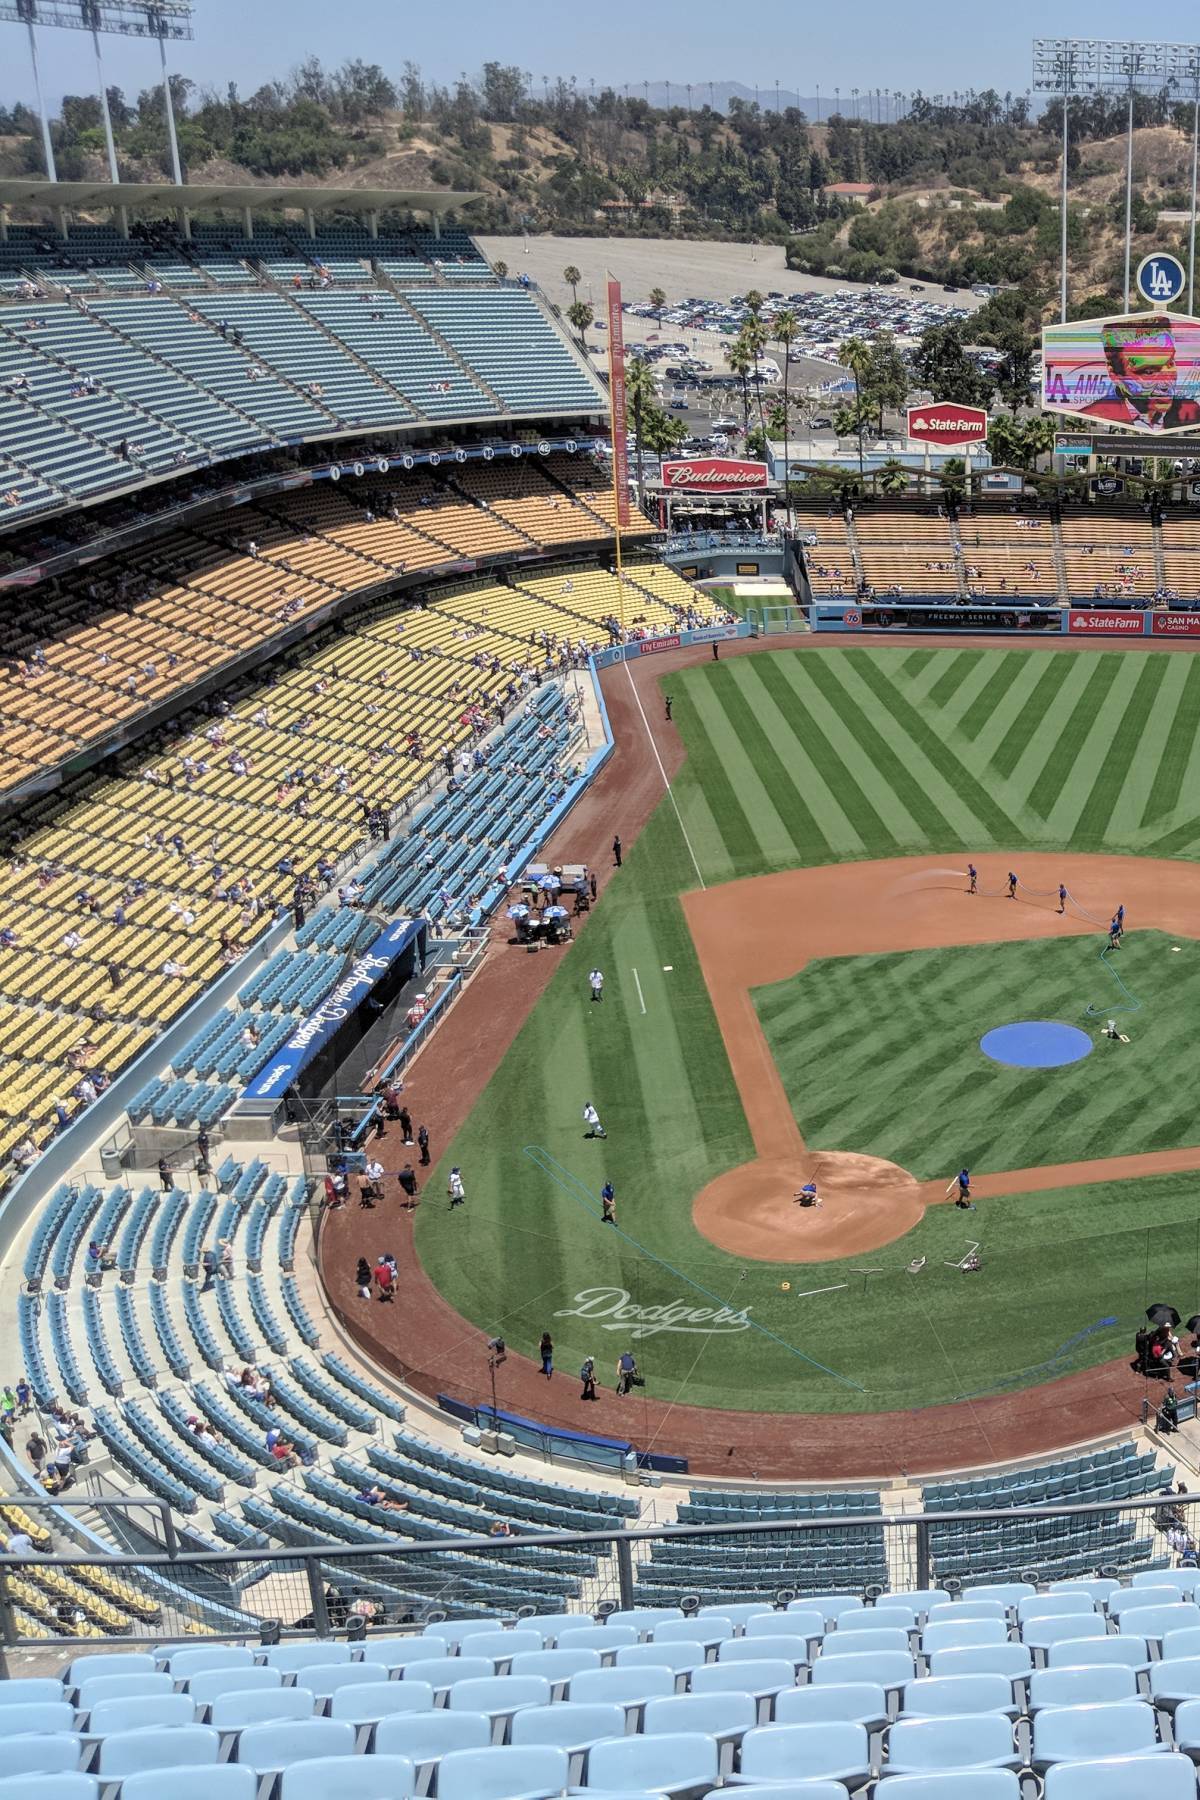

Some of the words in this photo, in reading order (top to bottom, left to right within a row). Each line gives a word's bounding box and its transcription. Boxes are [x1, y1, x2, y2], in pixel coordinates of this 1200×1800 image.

[1149, 262, 1172, 296] LA
[611, 303, 620, 342] Emirates
[612, 343, 621, 359] Fly
[615, 378, 623, 415] Emirates
[616, 416, 624, 433] Fly
[618, 452, 626, 489] Emirates
[667, 466, 765, 485] Budweiser
[846, 614, 859, 623] 76
[1167, 617, 1185, 625] SAN
[642, 642, 652, 652] Fly
[653, 638, 679, 649] Emirates
[329, 968, 374, 1006] Angeles
[288, 1005, 347, 1049] Dodgers
[552, 1287, 754, 1338] Dodgers
